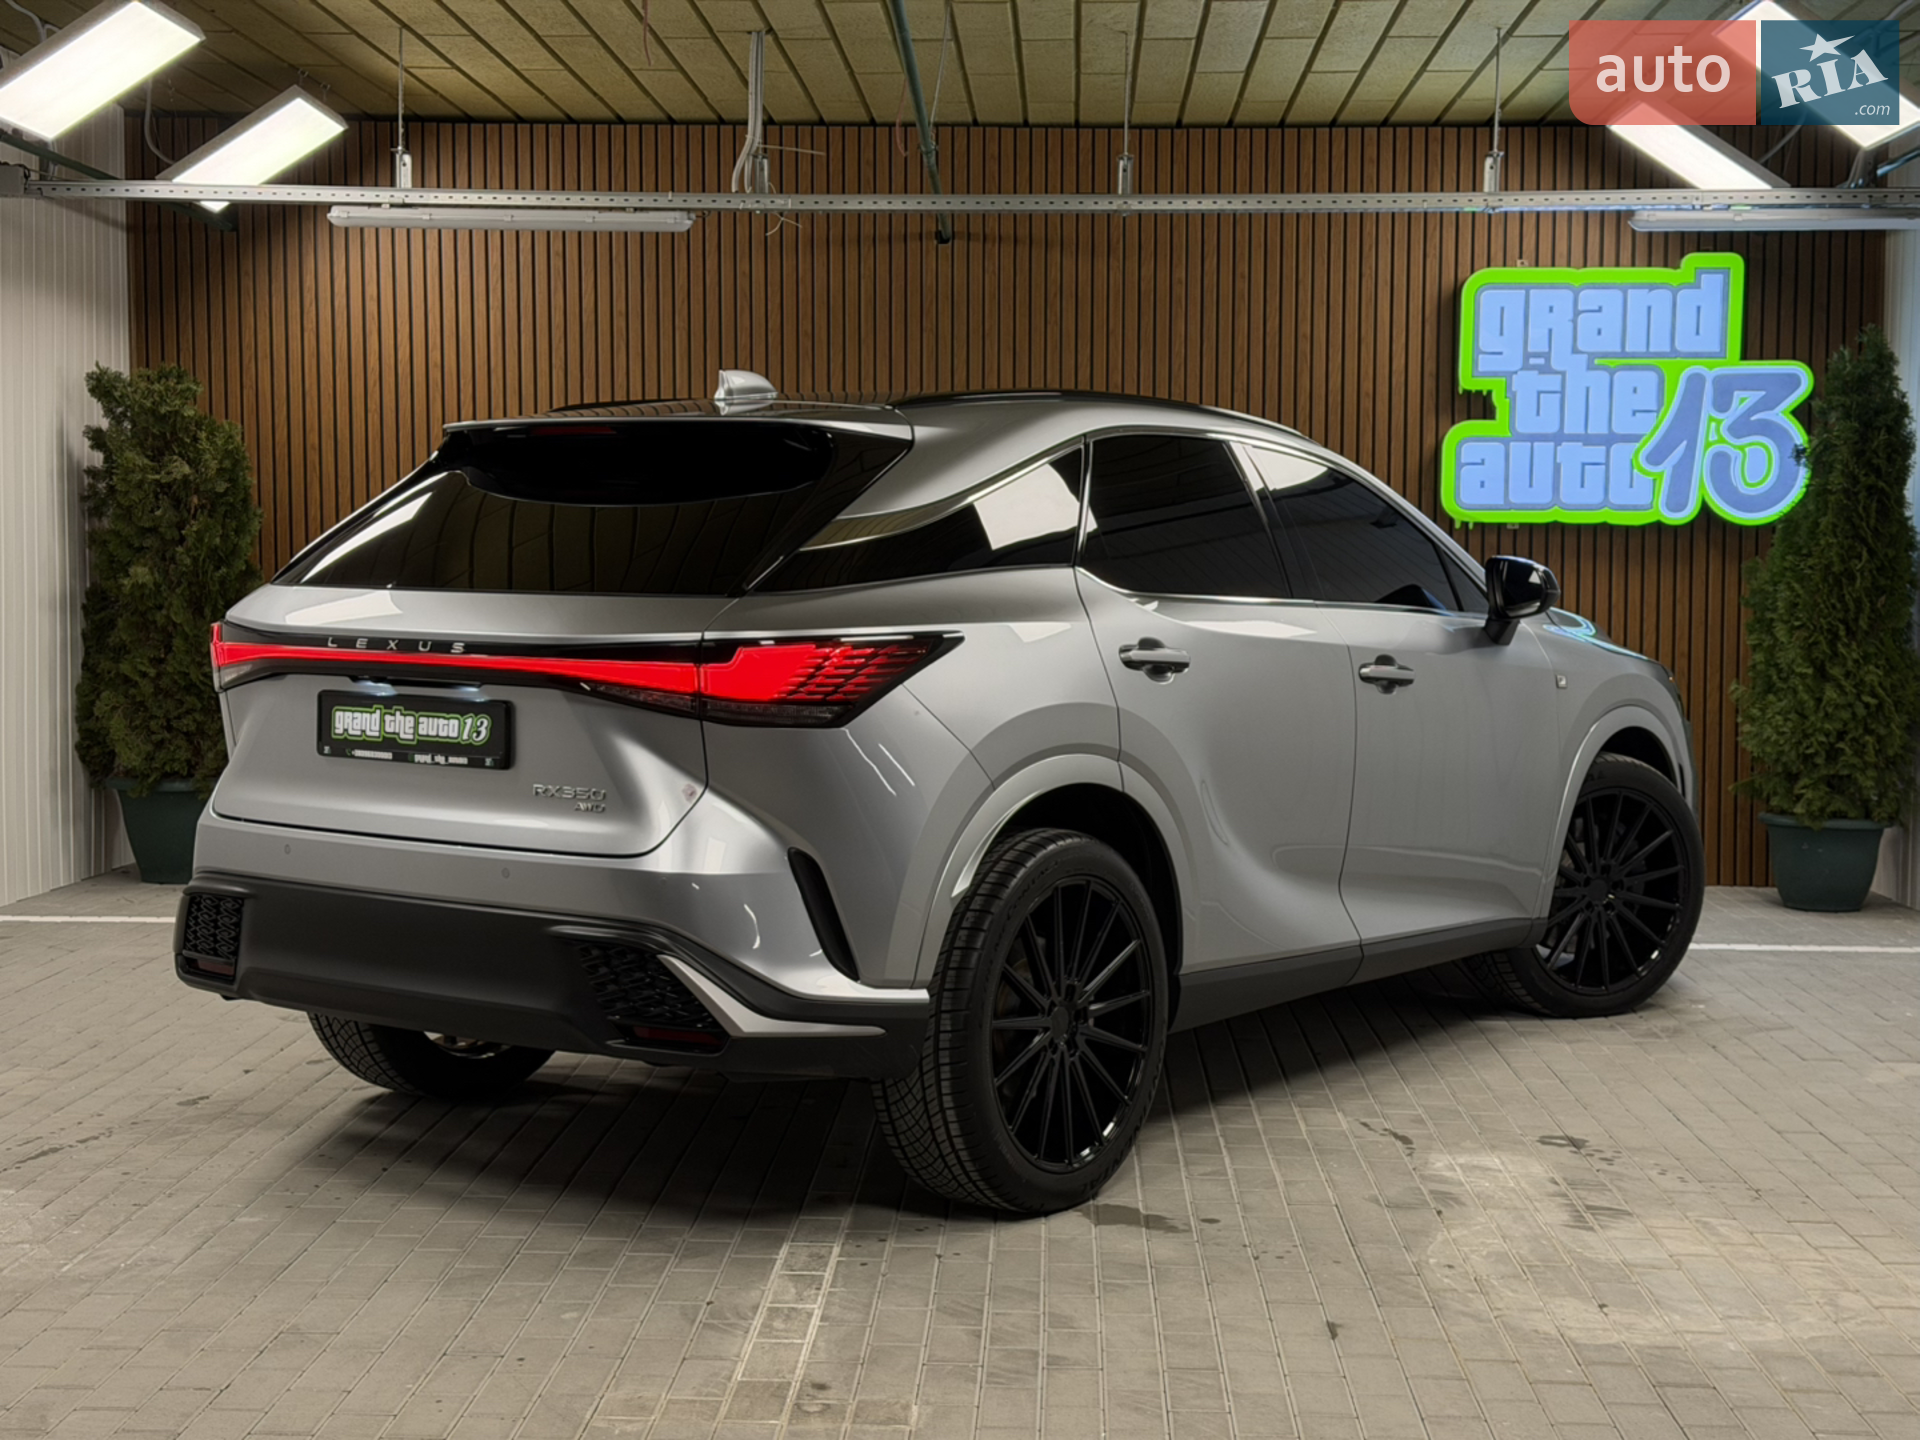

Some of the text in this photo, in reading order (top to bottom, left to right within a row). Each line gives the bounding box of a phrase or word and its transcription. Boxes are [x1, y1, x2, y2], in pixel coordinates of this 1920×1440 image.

[1512, 356, 1659, 434] the
[1640, 366, 1807, 517] 13
[1459, 442, 1655, 506] auto
[327, 636, 466, 654] LEXUS
[384, 710, 415, 740] the
[418, 715, 460, 738] auto
[462, 716, 489, 742] 13
[532, 783, 607, 801] RX350
[574, 801, 606, 813] AWD
